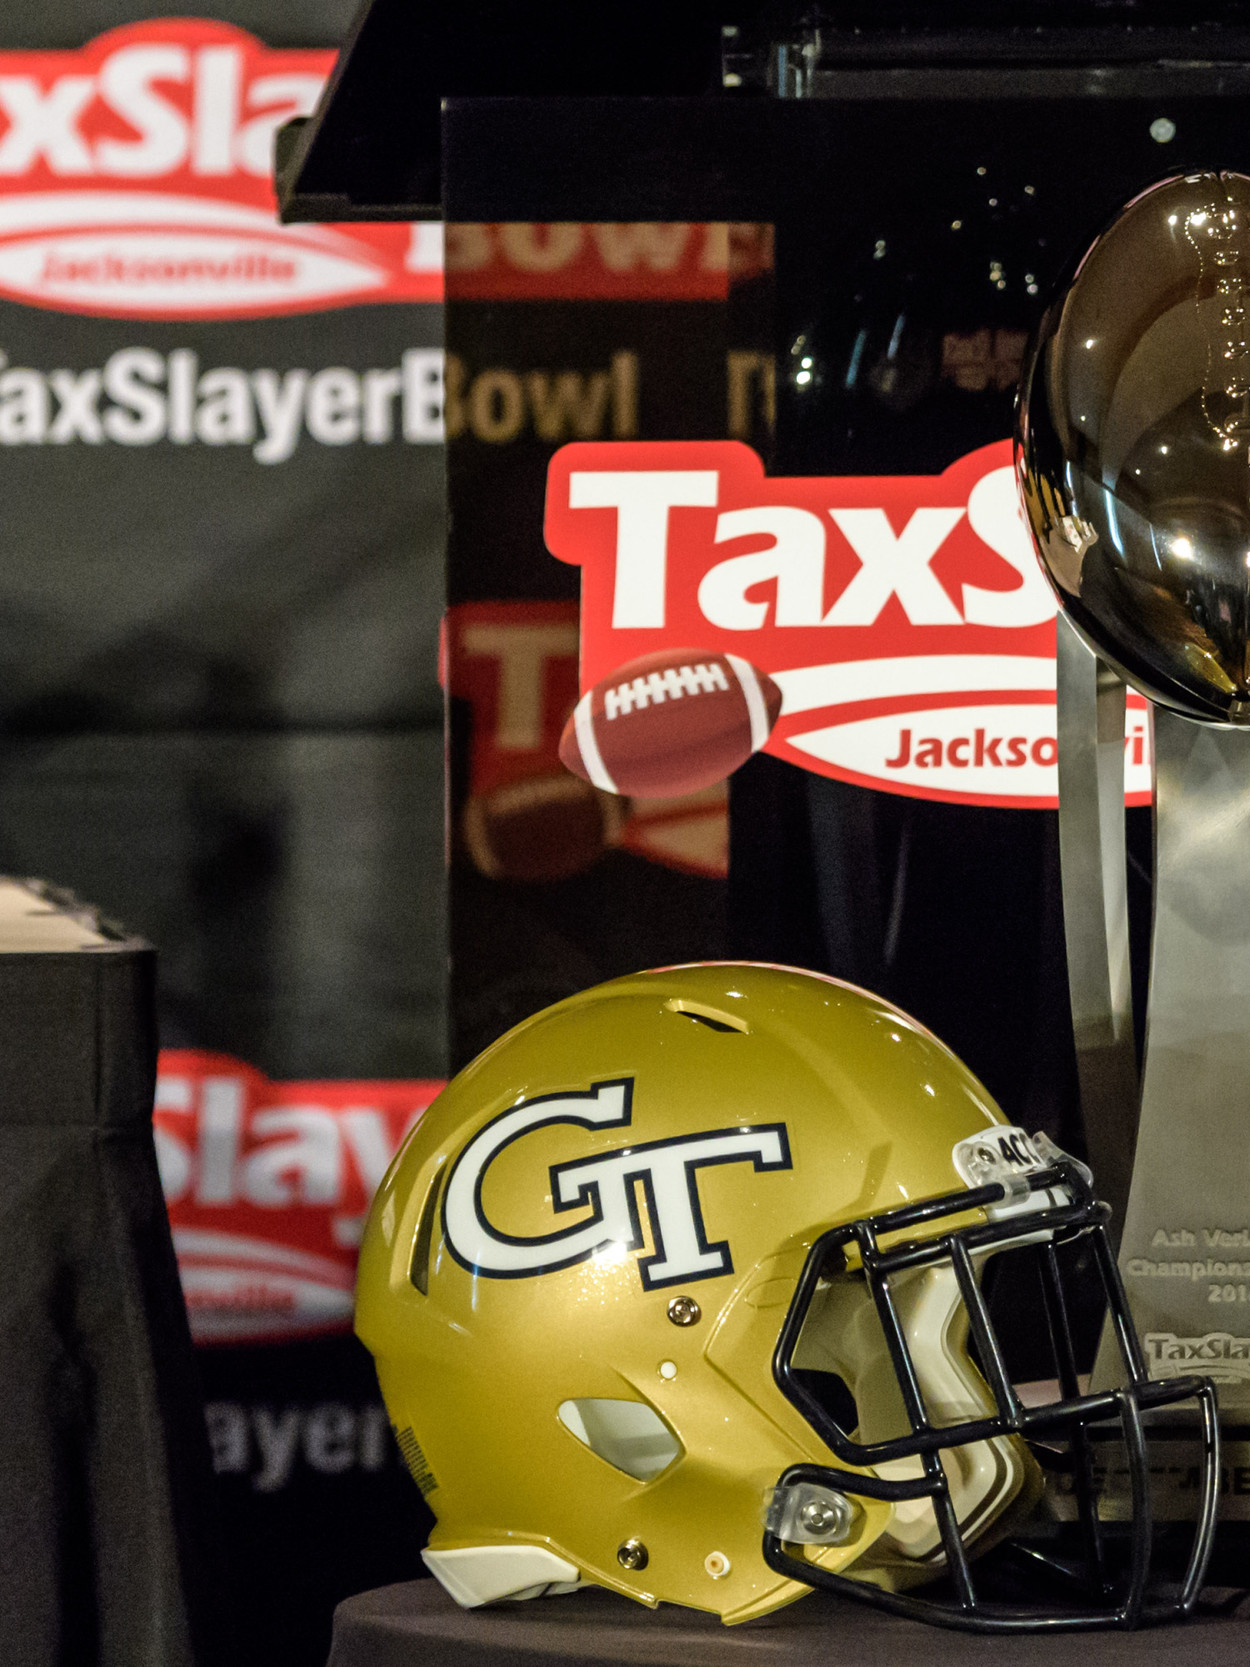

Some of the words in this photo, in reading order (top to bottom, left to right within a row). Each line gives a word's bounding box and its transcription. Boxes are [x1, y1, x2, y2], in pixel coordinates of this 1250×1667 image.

[0, 348, 638, 464] axSlayerBowl
[441, 1077, 792, 1292] GT
[1151, 1229, 1196, 1247] Ash
